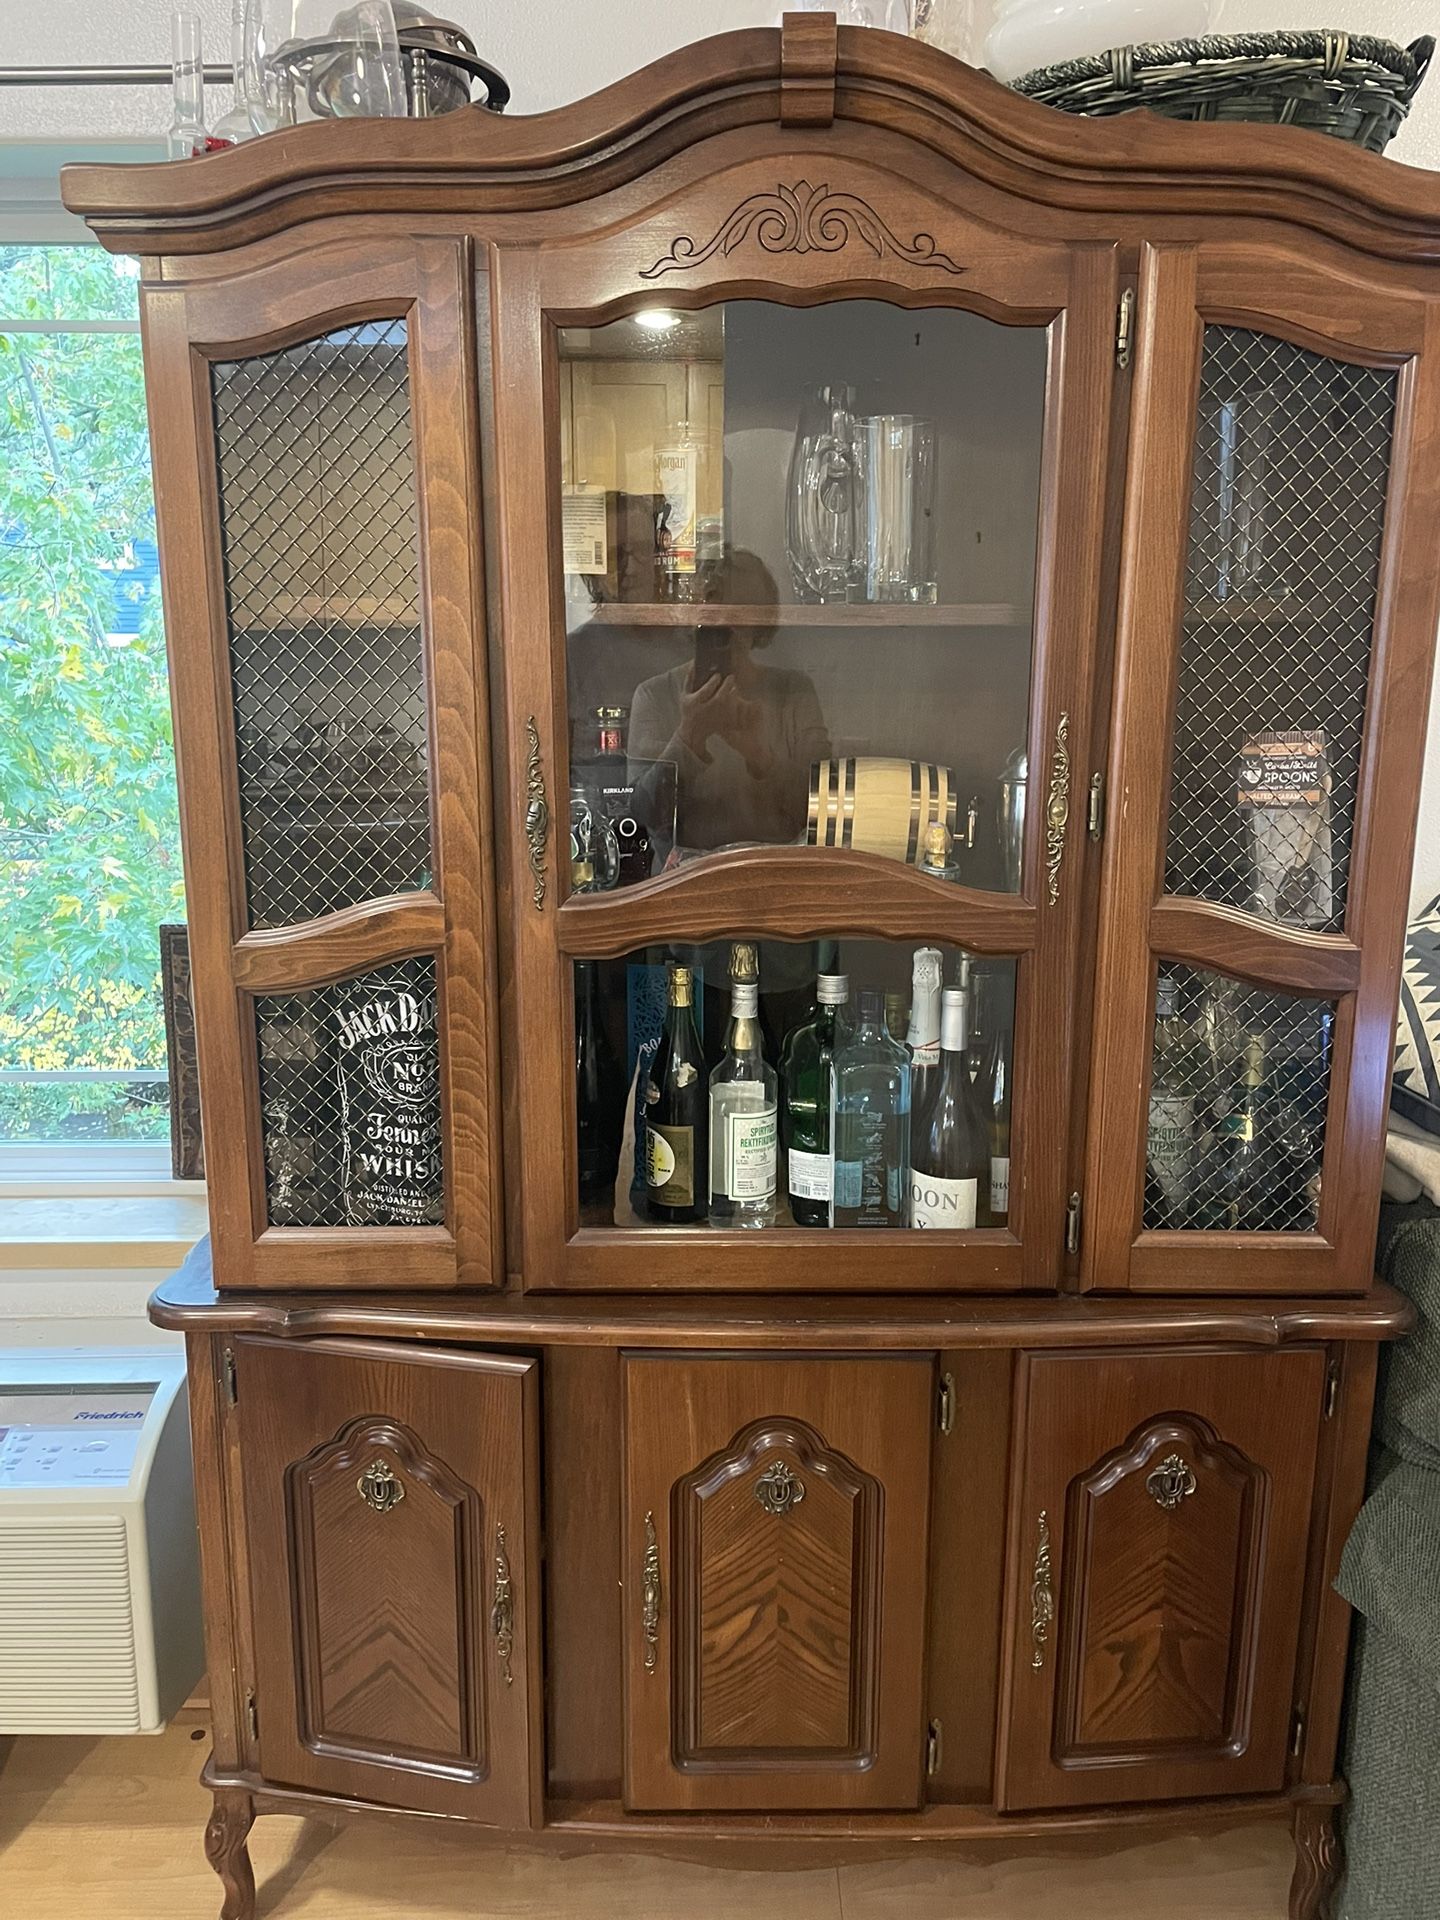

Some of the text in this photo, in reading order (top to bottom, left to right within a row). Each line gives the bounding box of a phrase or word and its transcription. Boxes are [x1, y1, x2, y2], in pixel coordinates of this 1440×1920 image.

[1264, 771, 1318, 783] SPOONS
[334, 1001, 398, 1050] JACK
[398, 1082, 434, 1095] BRAND
[375, 1143, 414, 1157] SOUR
[357, 1190, 385, 1202] JACK
[73, 1411, 144, 1421] Friedrich
